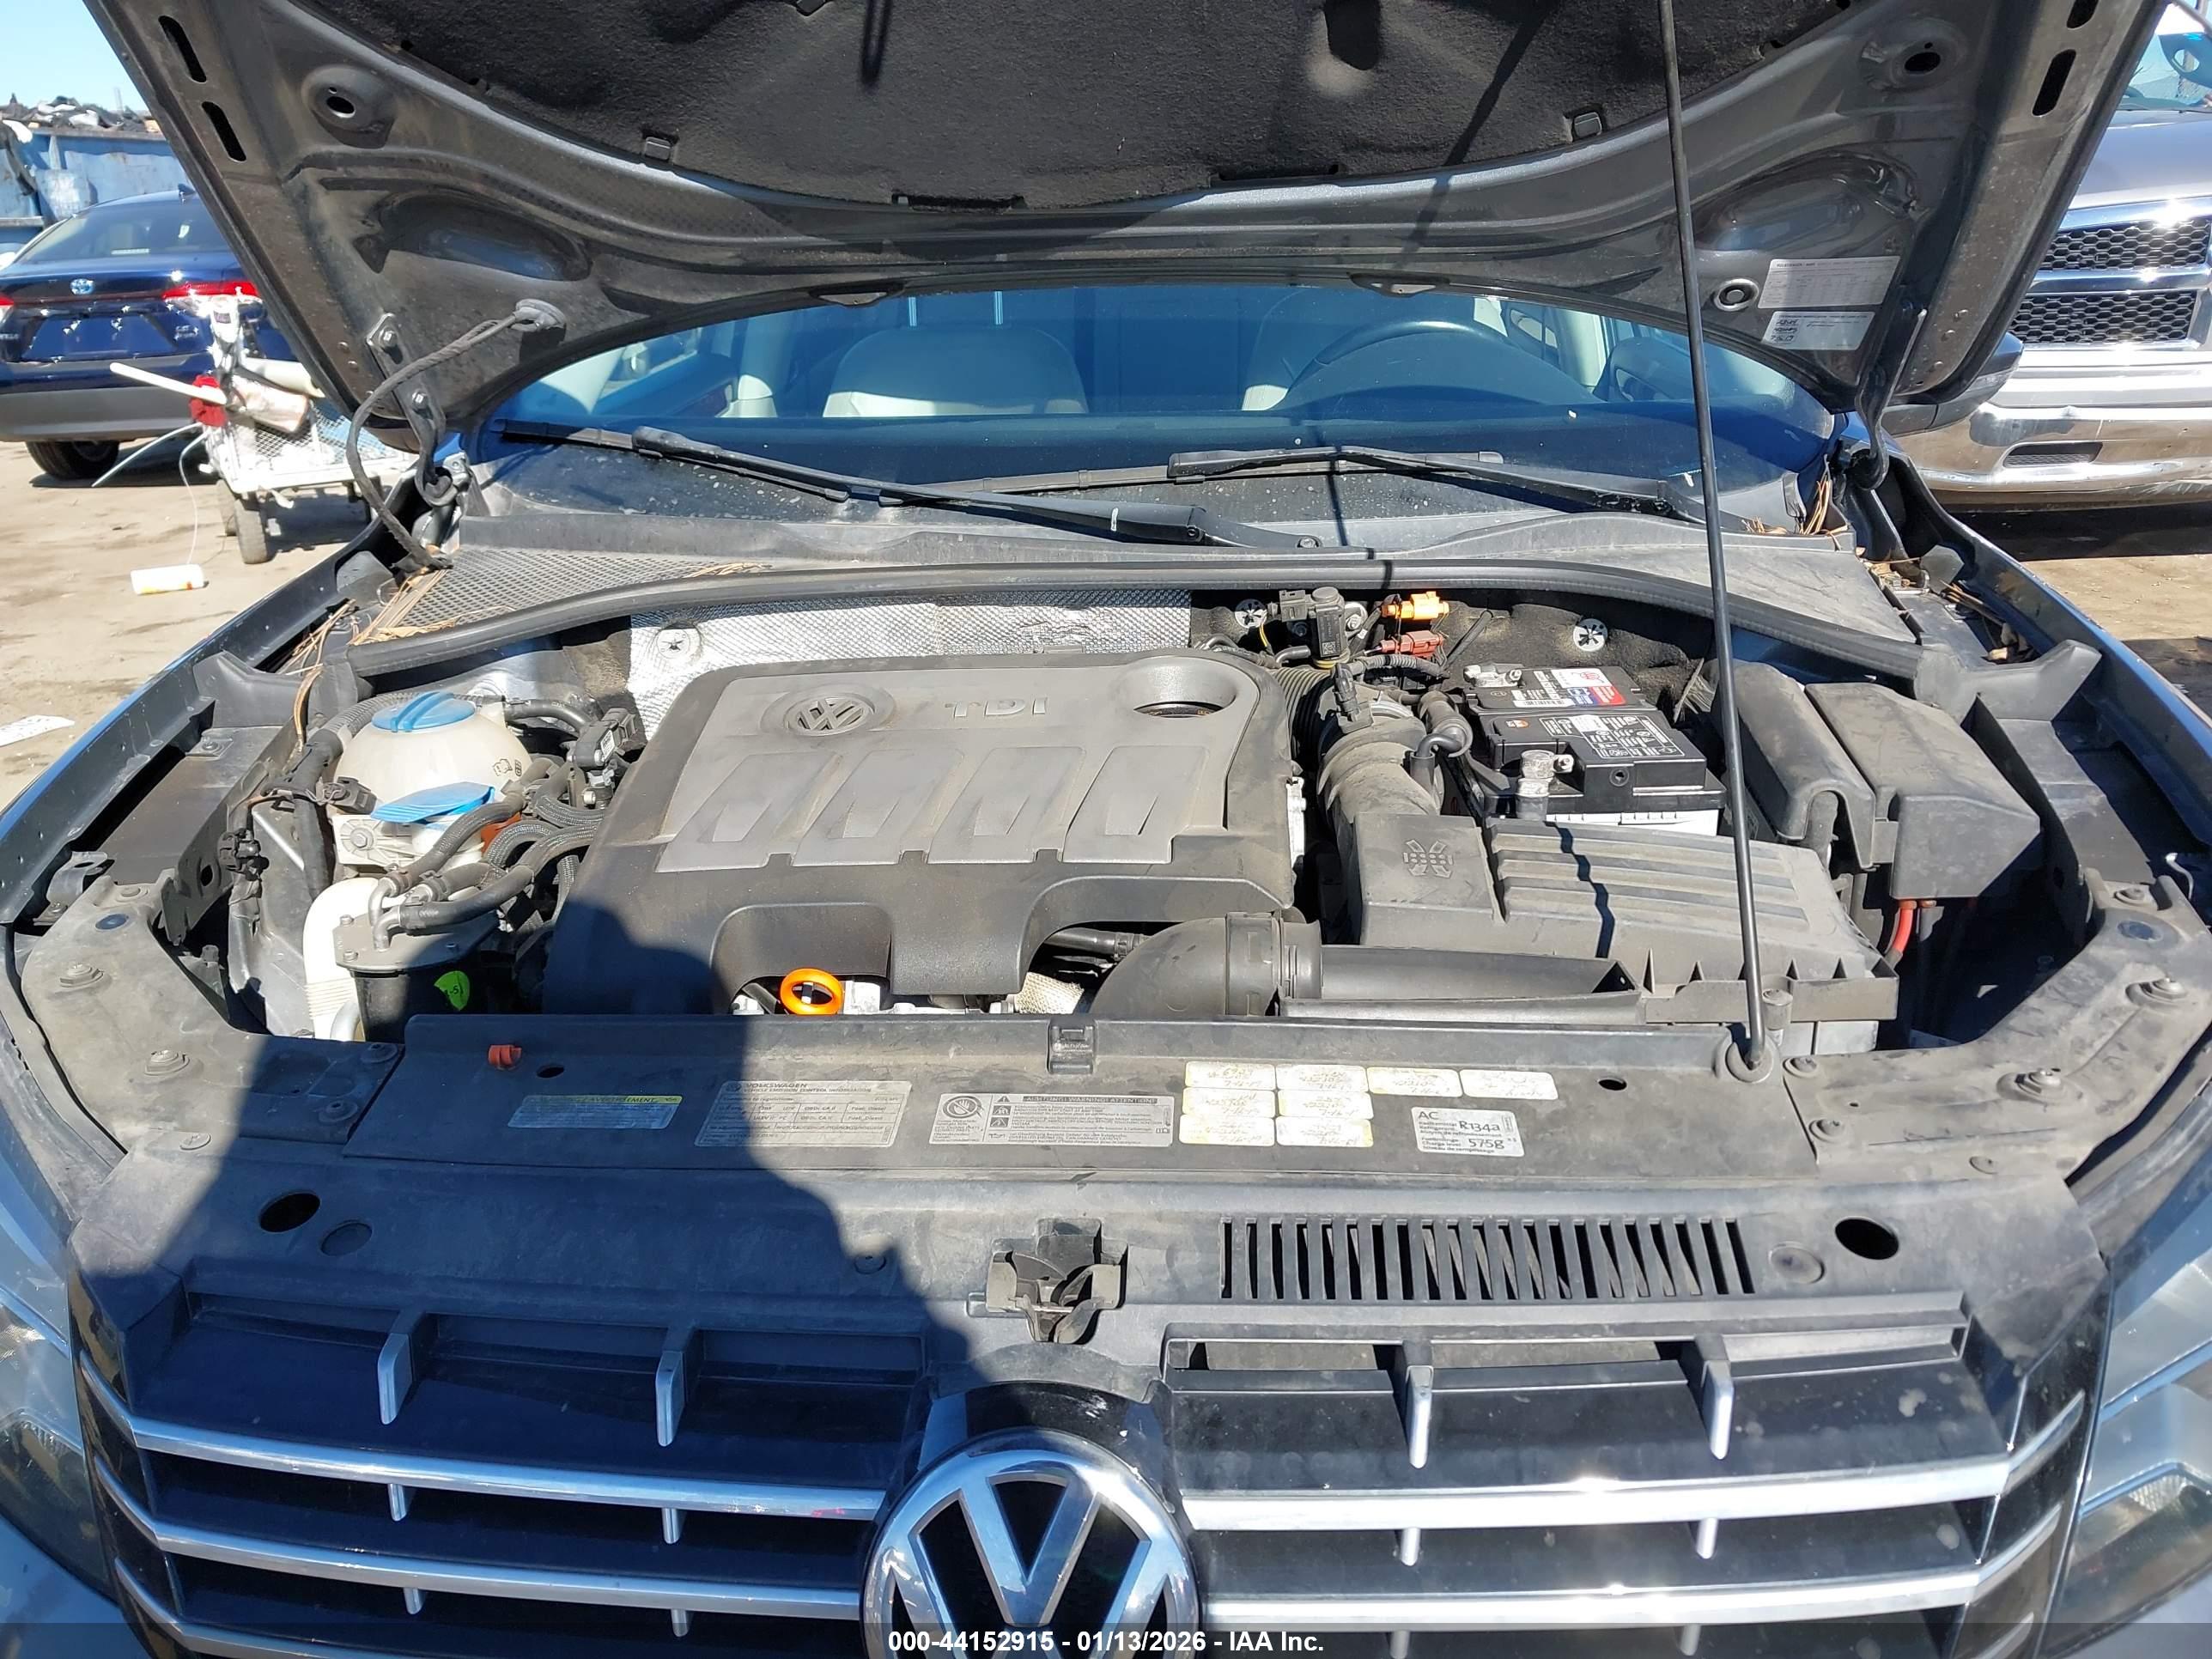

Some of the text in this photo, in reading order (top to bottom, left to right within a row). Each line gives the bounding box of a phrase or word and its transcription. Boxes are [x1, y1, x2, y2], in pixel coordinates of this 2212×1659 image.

[945, 696, 1048, 719] TDI
[1419, 1111, 1439, 1120] AC
[1459, 1121, 1501, 1133] R134a
